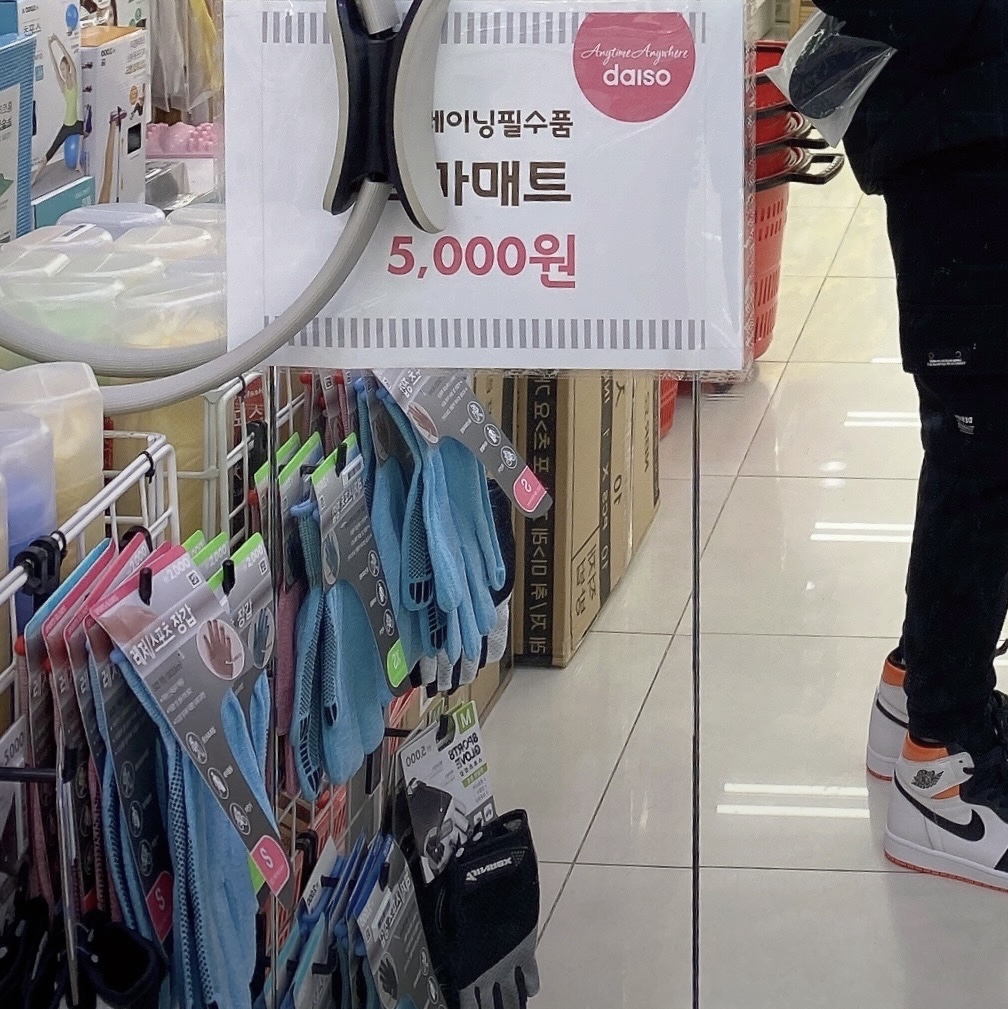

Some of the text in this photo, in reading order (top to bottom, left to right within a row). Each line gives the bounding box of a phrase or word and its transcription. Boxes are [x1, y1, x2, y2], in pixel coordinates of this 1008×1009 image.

[629, 42, 690, 64] Anywhere
[602, 63, 672, 88] daiso
[436, 160, 572, 207] 가매트
[386, 233, 577, 289] 5,000원
[237, 598, 254, 629] 장갑
[128, 603, 198, 666] 레저/스포츠 장갑
[259, 846, 274, 869] S
